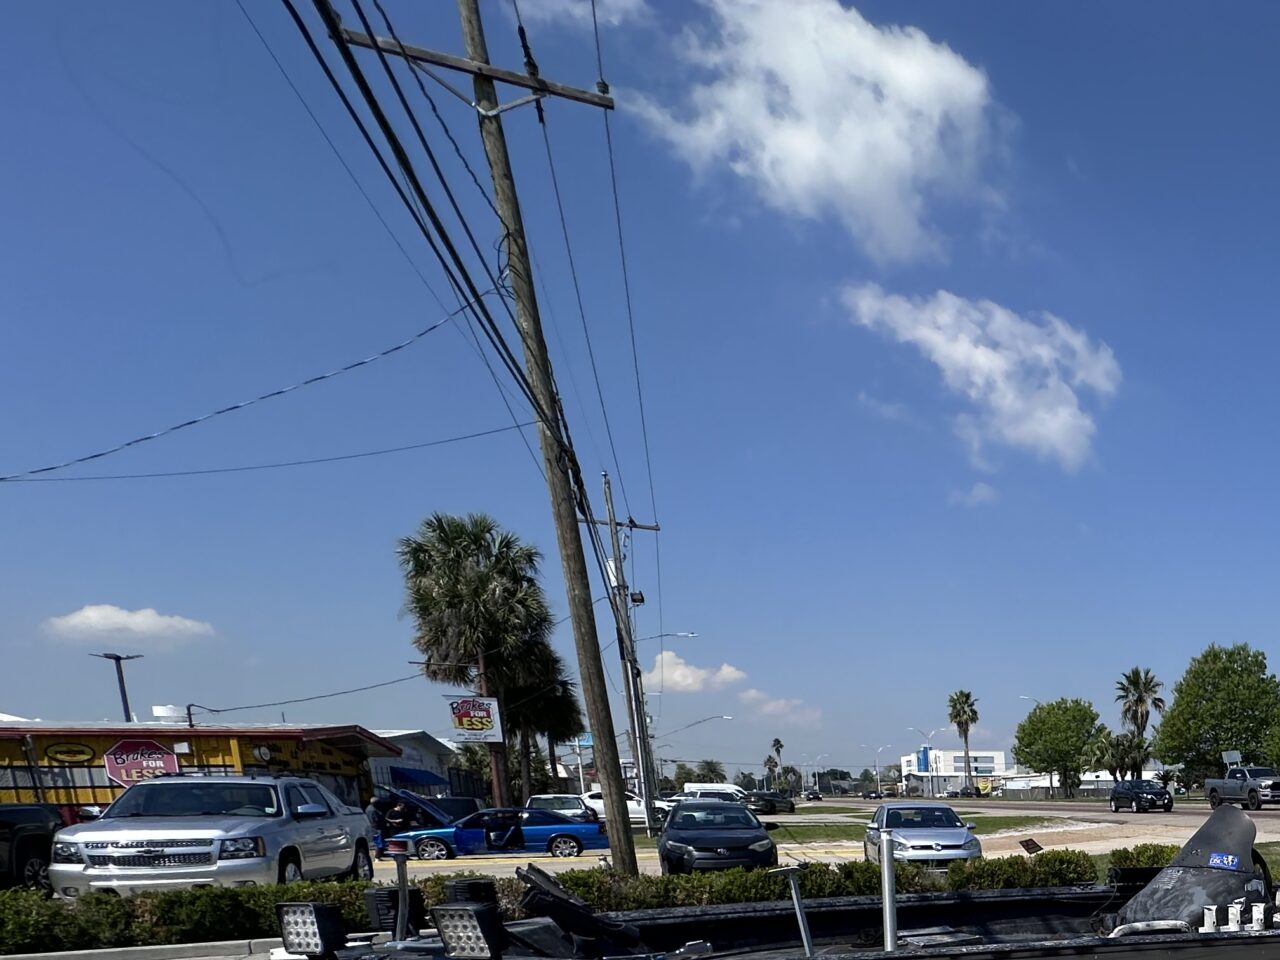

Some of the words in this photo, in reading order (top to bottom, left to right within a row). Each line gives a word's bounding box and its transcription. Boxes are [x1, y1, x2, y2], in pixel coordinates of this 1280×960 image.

[449, 699, 492, 715] Brakes
[452, 717, 494, 730] LESS
[113, 746, 165, 766] Brakes
[142, 760, 165, 768] FOR
